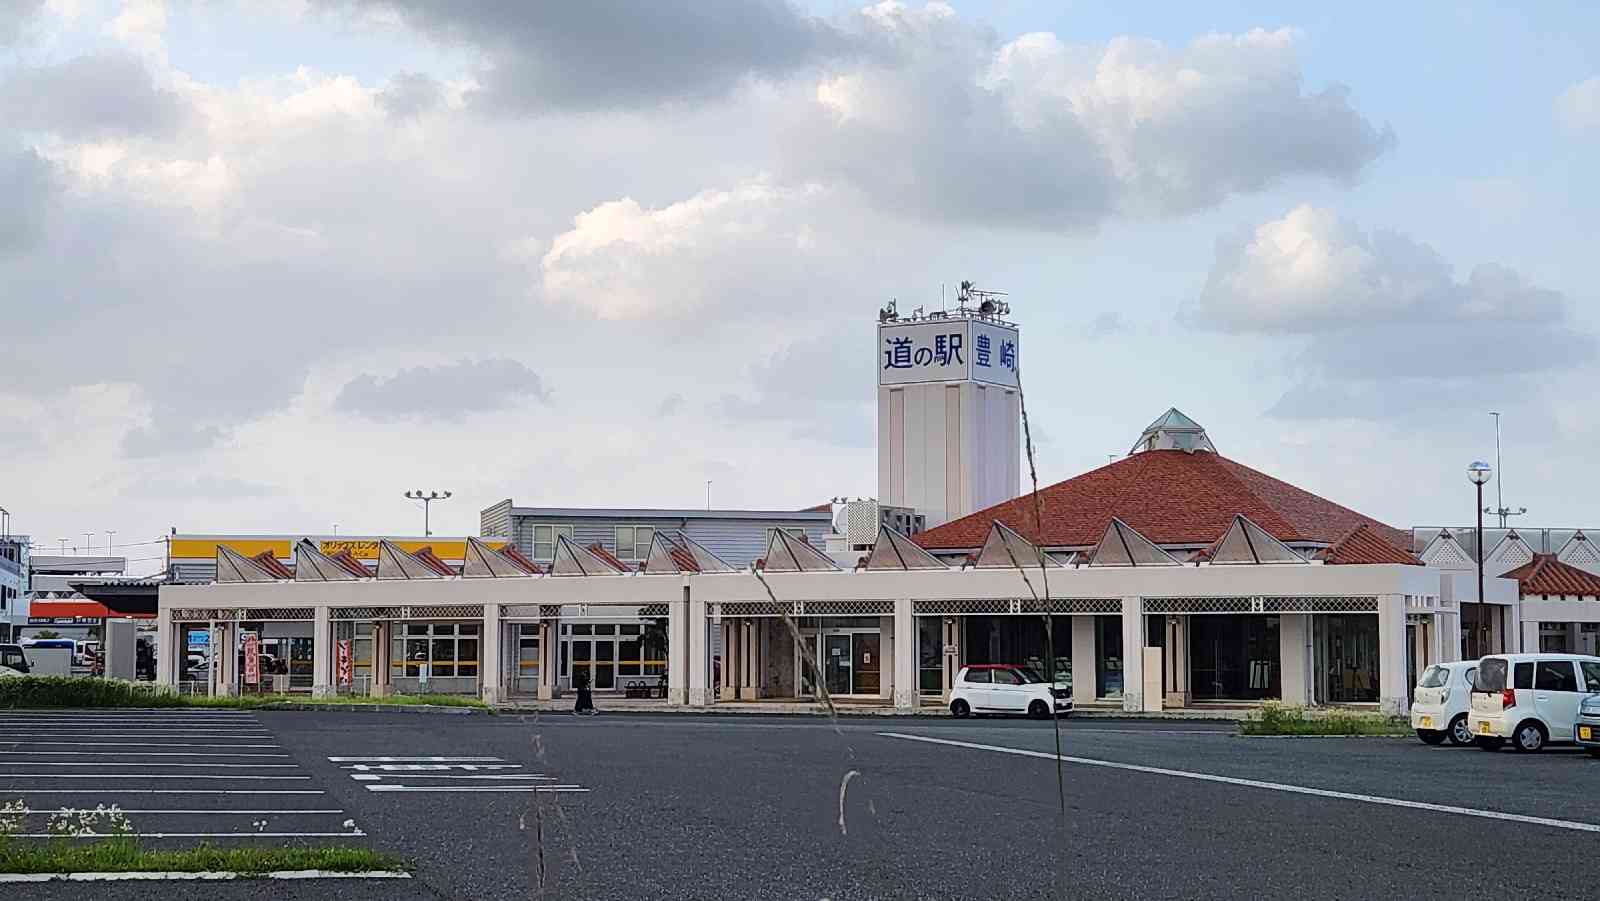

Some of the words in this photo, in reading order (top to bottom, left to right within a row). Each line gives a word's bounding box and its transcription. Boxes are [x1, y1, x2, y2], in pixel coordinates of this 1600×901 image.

[884, 333, 964, 370] 道の駅
[975, 333, 1017, 373] 豊崎
